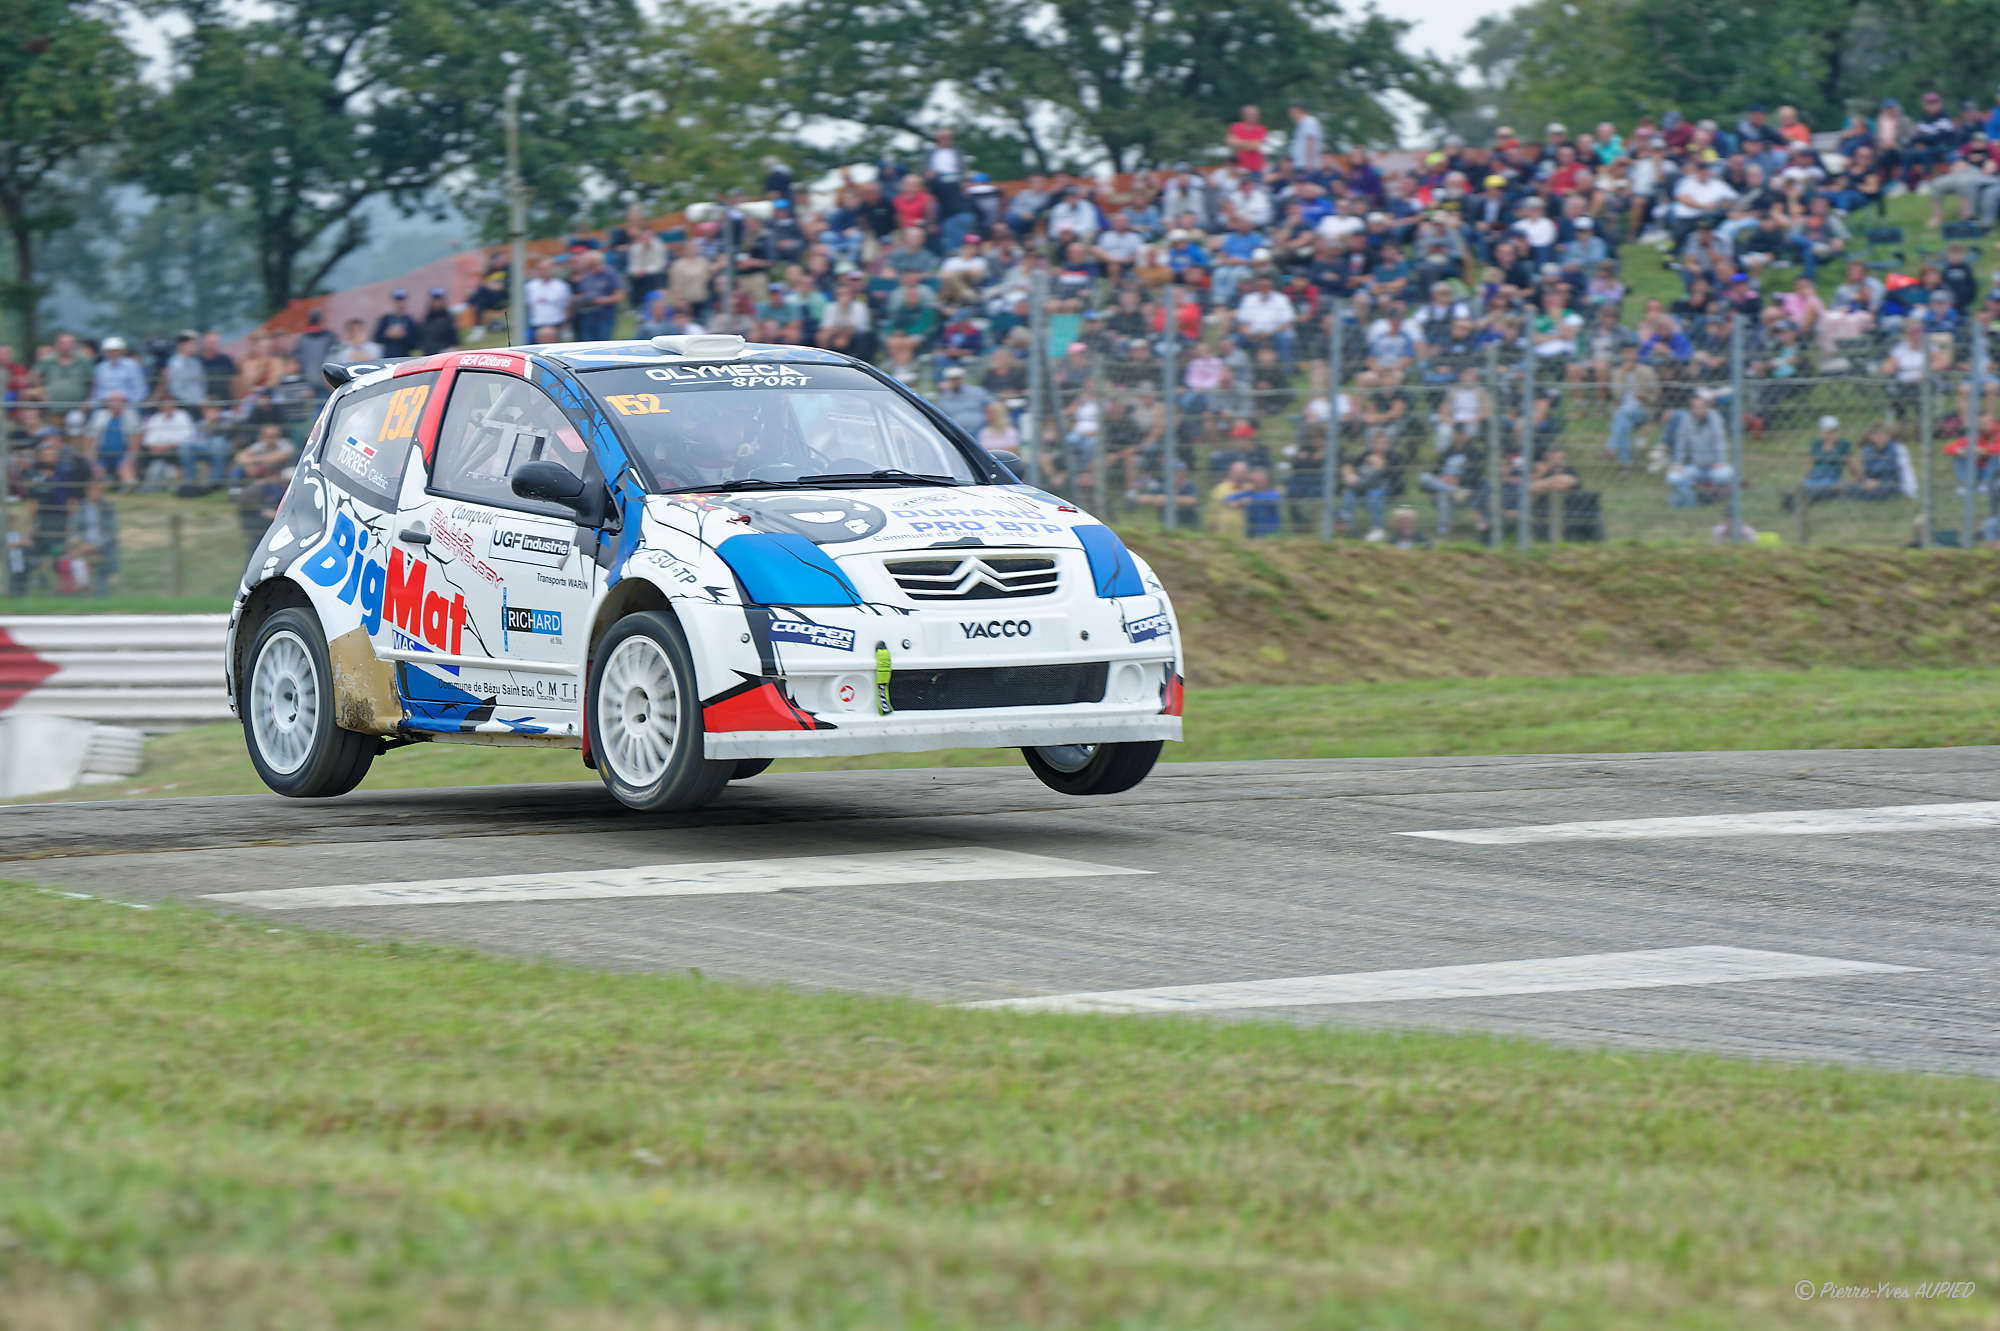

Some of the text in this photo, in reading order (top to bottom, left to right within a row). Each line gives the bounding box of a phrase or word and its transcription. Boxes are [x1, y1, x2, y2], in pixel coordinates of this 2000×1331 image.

[645, 364, 805, 381] OLYMECA
[731, 376, 813, 387] SPORT
[378, 385, 430, 442] 152
[604, 393, 671, 416] 152
[337, 445, 371, 476] TORRES
[890, 508, 1047, 520] DURAND
[909, 520, 1064, 533] PRO BTP
[493, 530, 569, 555] UGF industrie
[537, 573, 588, 590] Transports WARIN
[508, 611, 560, 631] RICHARD
[960, 620, 1031, 639] YACCO
[771, 621, 854, 641] COOPER
[810, 635, 852, 649] TIRES
[438, 679, 534, 697] Commune de Bézu Saint Eloi
